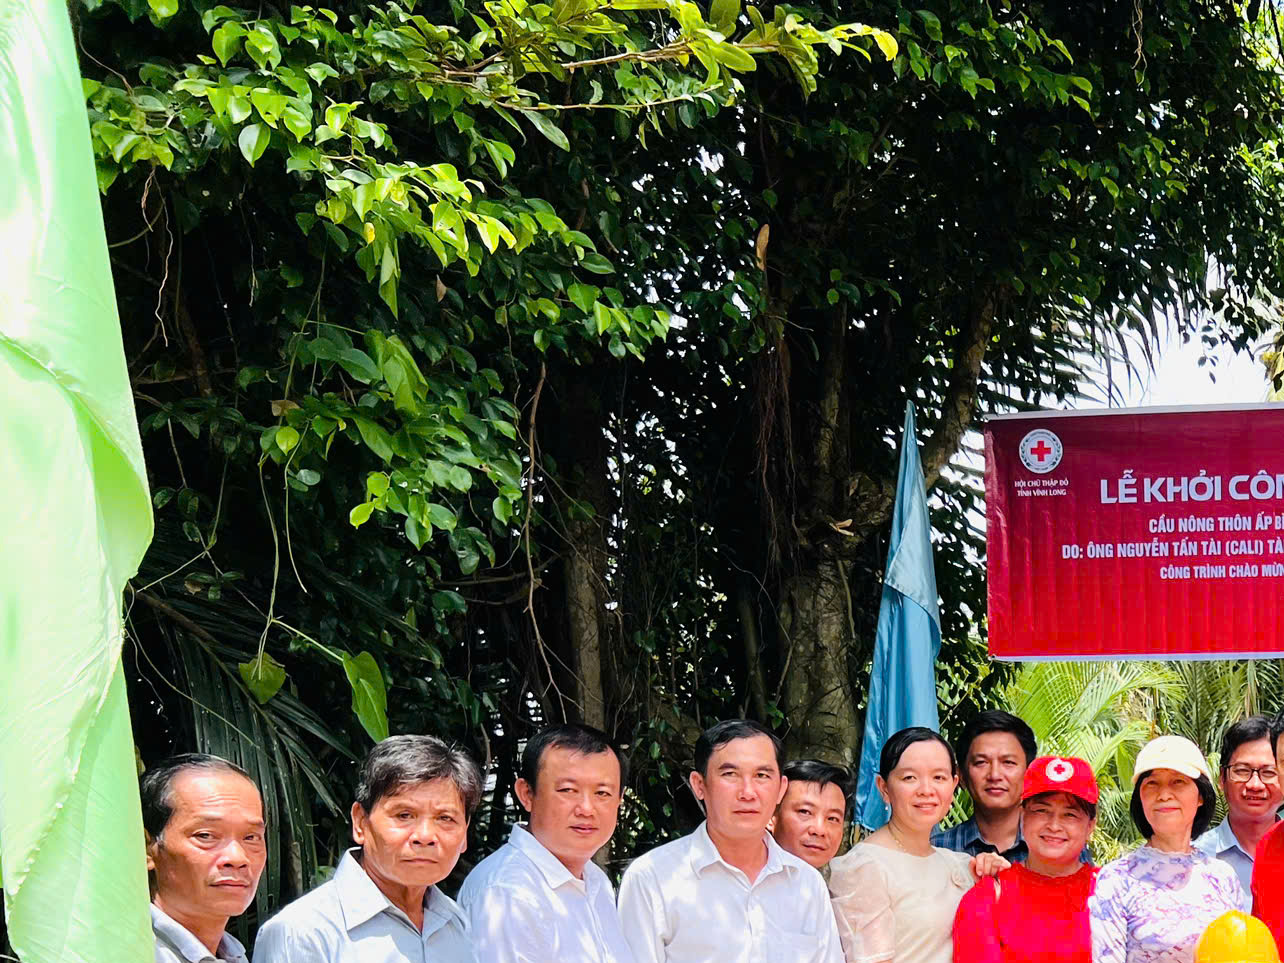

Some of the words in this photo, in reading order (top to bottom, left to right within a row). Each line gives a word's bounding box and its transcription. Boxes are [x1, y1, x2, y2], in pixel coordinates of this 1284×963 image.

[1100, 469, 1138, 504] LỄ
[1143, 470, 1222, 504] KHỞI
[1178, 514, 1214, 534] NÔNG
[1218, 514, 1251, 532] THÔN
[1255, 512, 1272, 531] ẤP
[1086, 541, 1114, 558] ÔNG
[1117, 538, 1169, 558] NGUYỄN
[1172, 536, 1198, 557] TẤN
[1201, 538, 1221, 556] TÀI
[1225, 540, 1264, 556] (CALI)
[1160, 564, 1191, 580] CÔNG
[1193, 563, 1226, 579] TRÌNH
[1228, 563, 1258, 578] CHÀO
